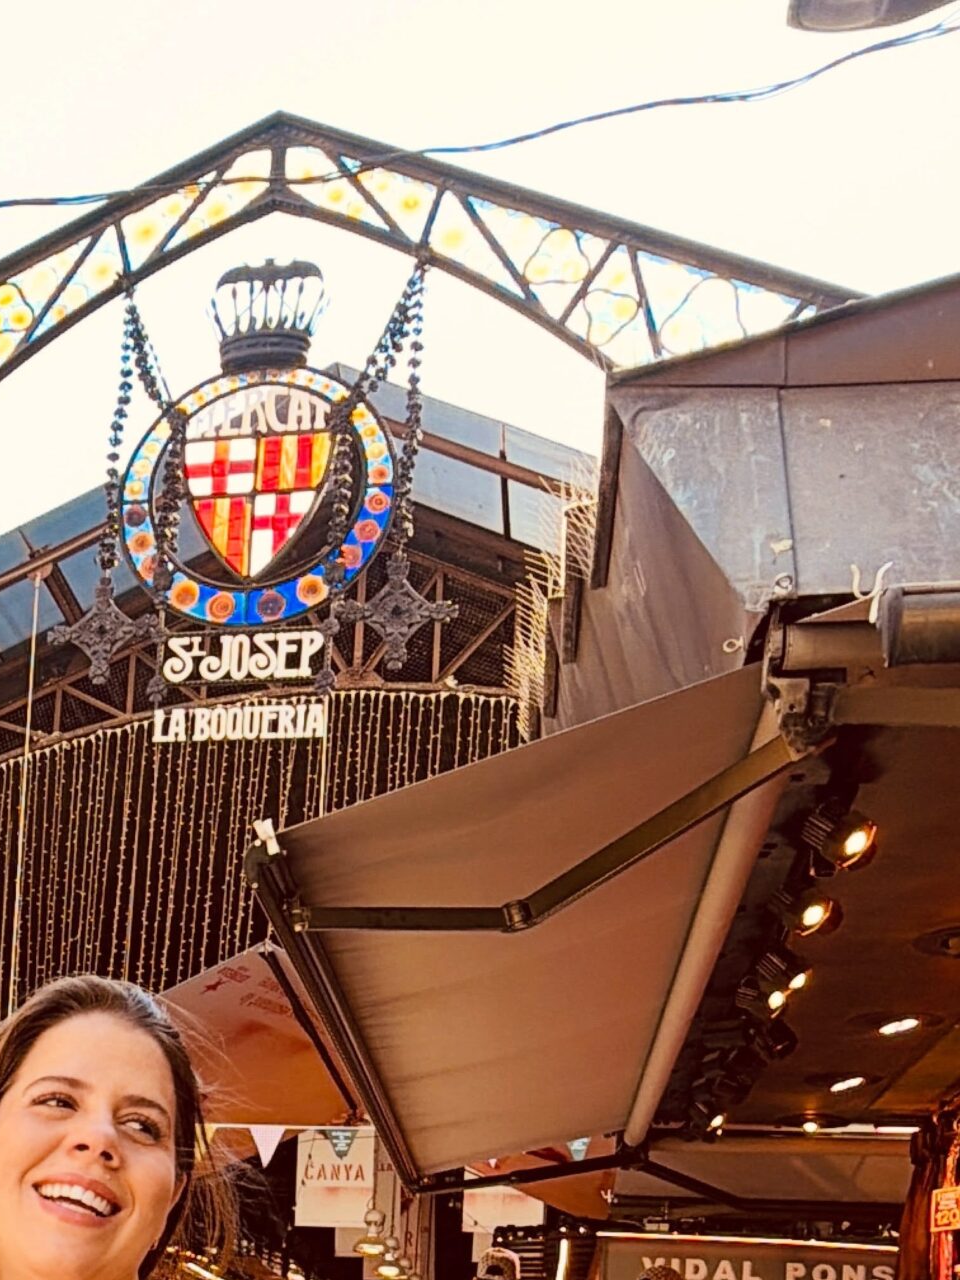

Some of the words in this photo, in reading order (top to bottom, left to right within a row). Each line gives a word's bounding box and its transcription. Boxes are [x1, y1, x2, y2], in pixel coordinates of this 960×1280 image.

[186, 386, 331, 438] MERCAT
[198, 631, 325, 681] JOSEP
[152, 708, 187, 743] LA
[192, 703, 325, 742] BOQUERIA
[304, 1161, 366, 1181] CANYA
